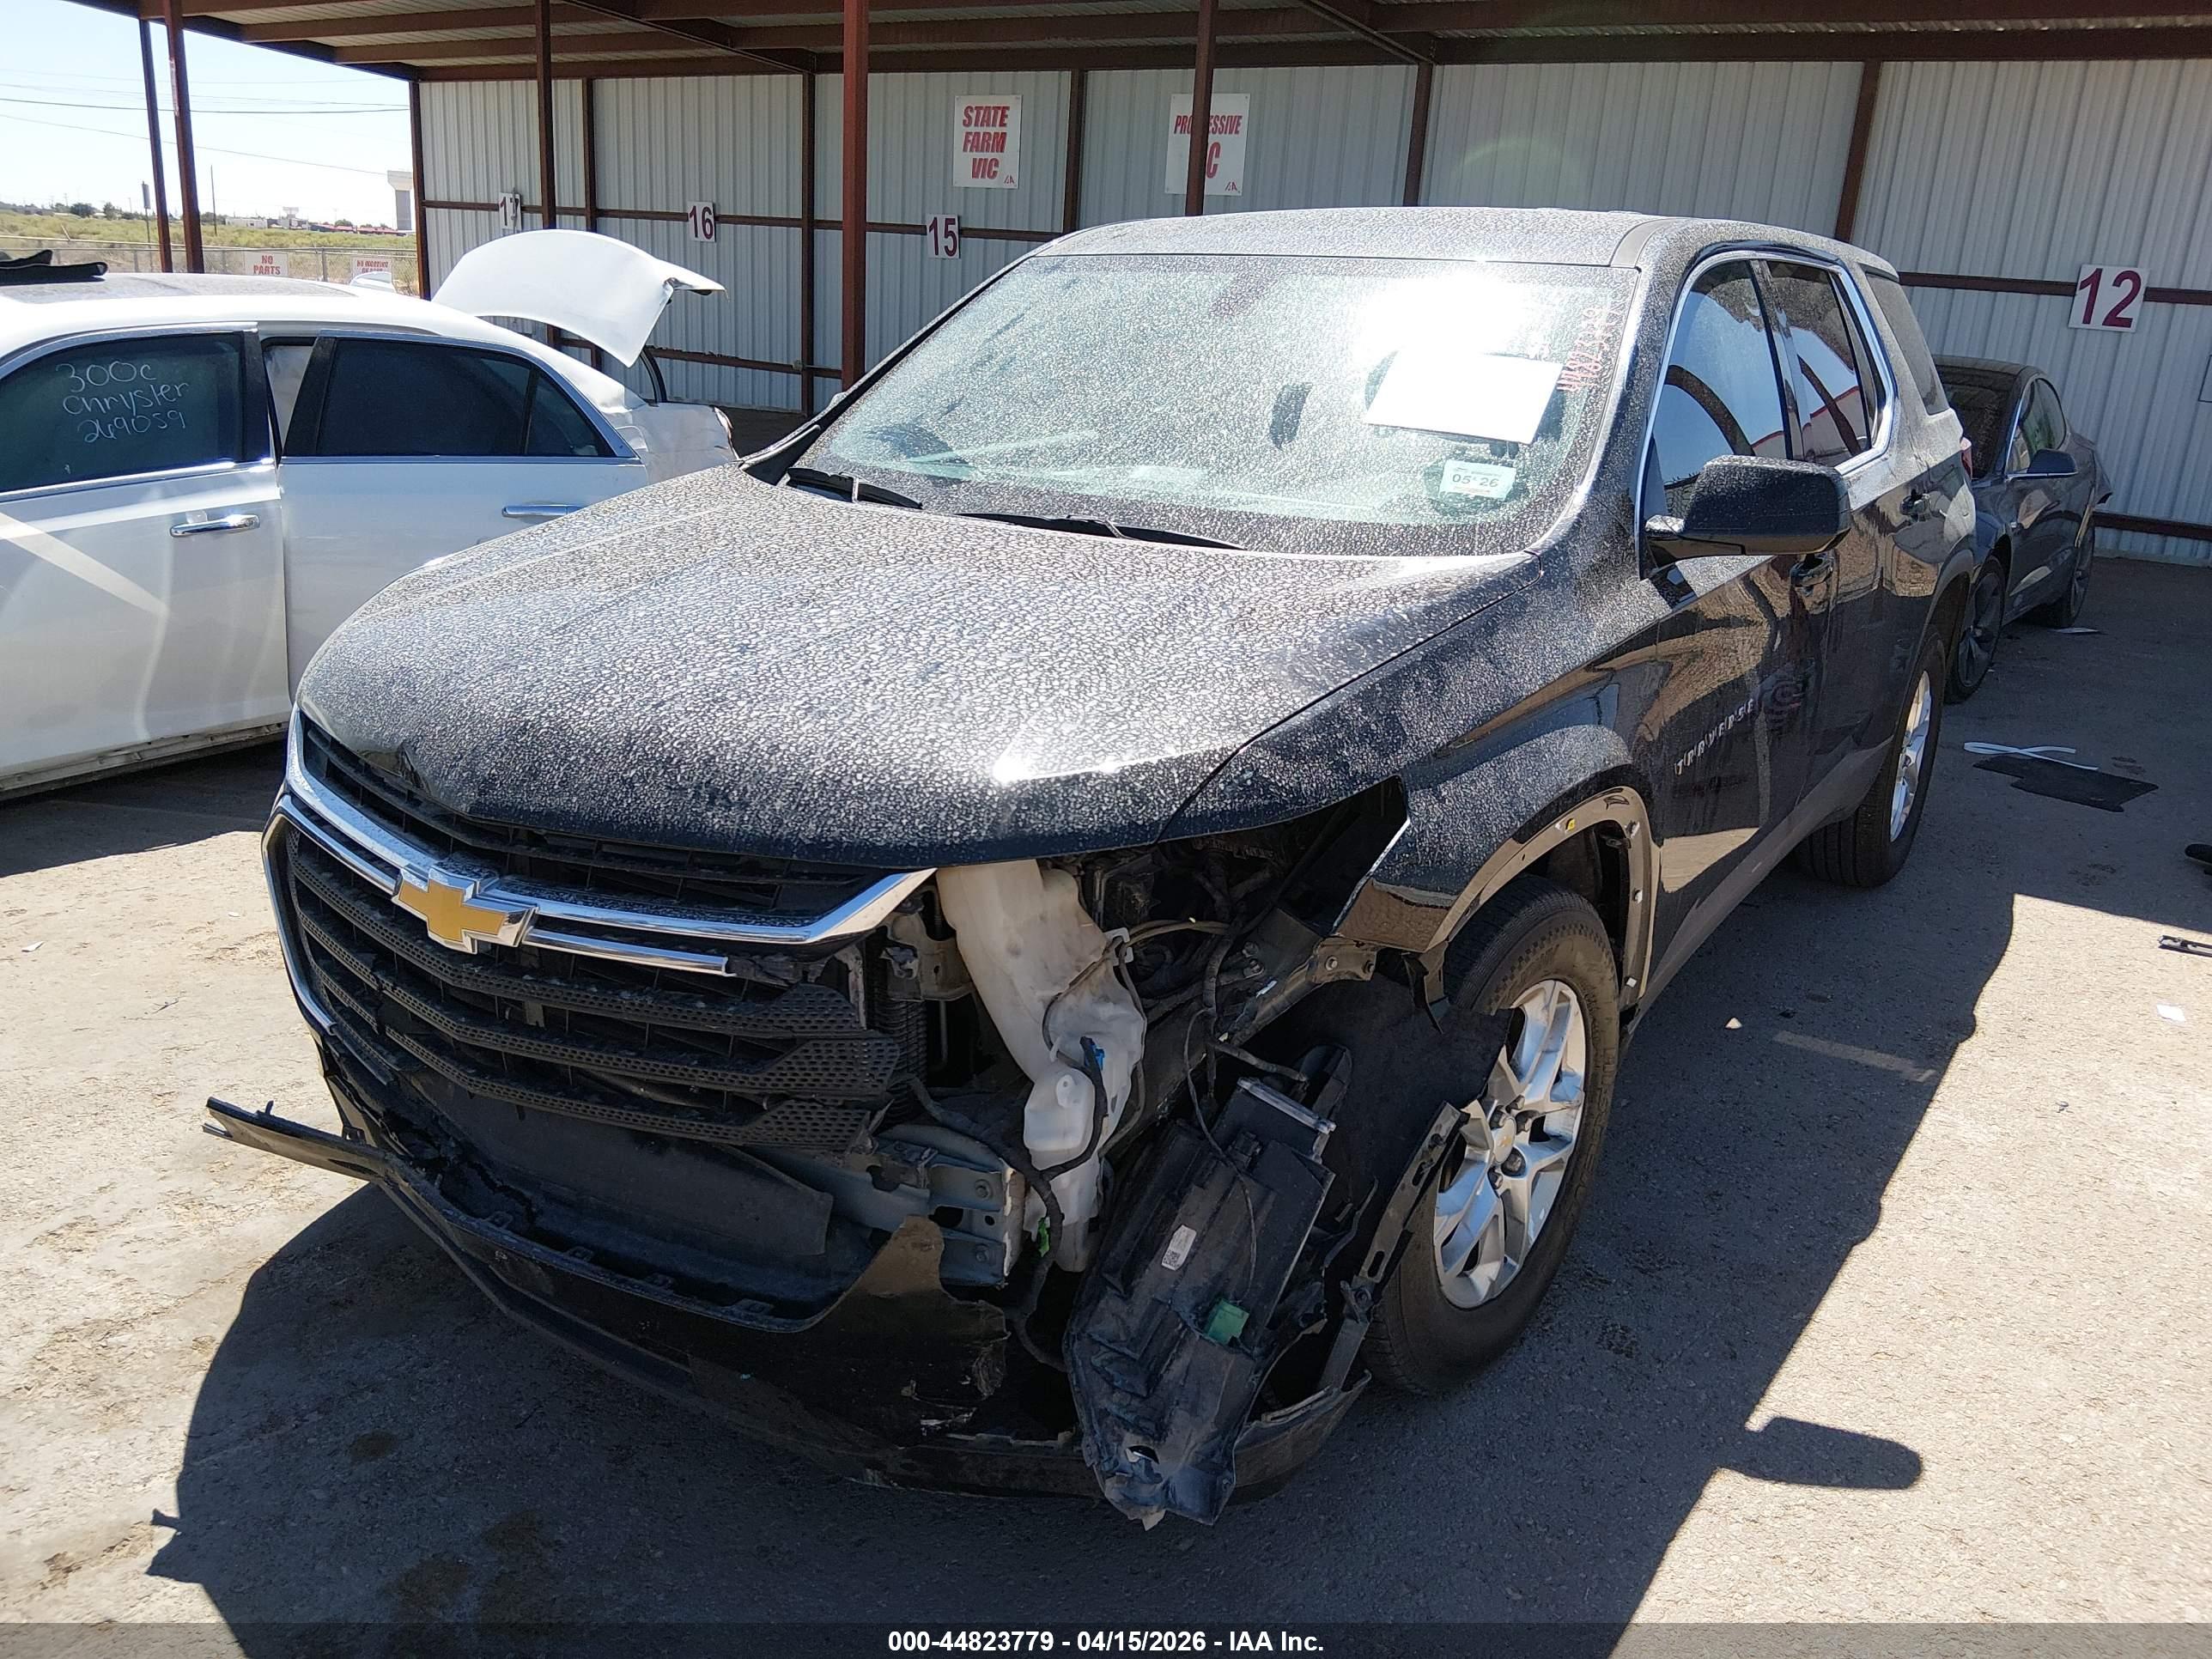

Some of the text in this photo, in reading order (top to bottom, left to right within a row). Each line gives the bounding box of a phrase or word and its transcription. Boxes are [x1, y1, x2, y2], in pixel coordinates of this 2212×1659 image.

[963, 106, 1011, 128] STATE
[1174, 114, 1243, 135] PROESSIVE
[963, 131, 1007, 153] FARM
[971, 157, 1000, 179] VIC
[499, 195, 520, 227] 17
[689, 205, 714, 240] 16
[928, 216, 958, 257] 15
[253, 264, 281, 276] PARTS
[262, 255, 274, 264] NO
[2079, 268, 2142, 329] 12
[1674, 698, 1754, 775] TRAVERSE
